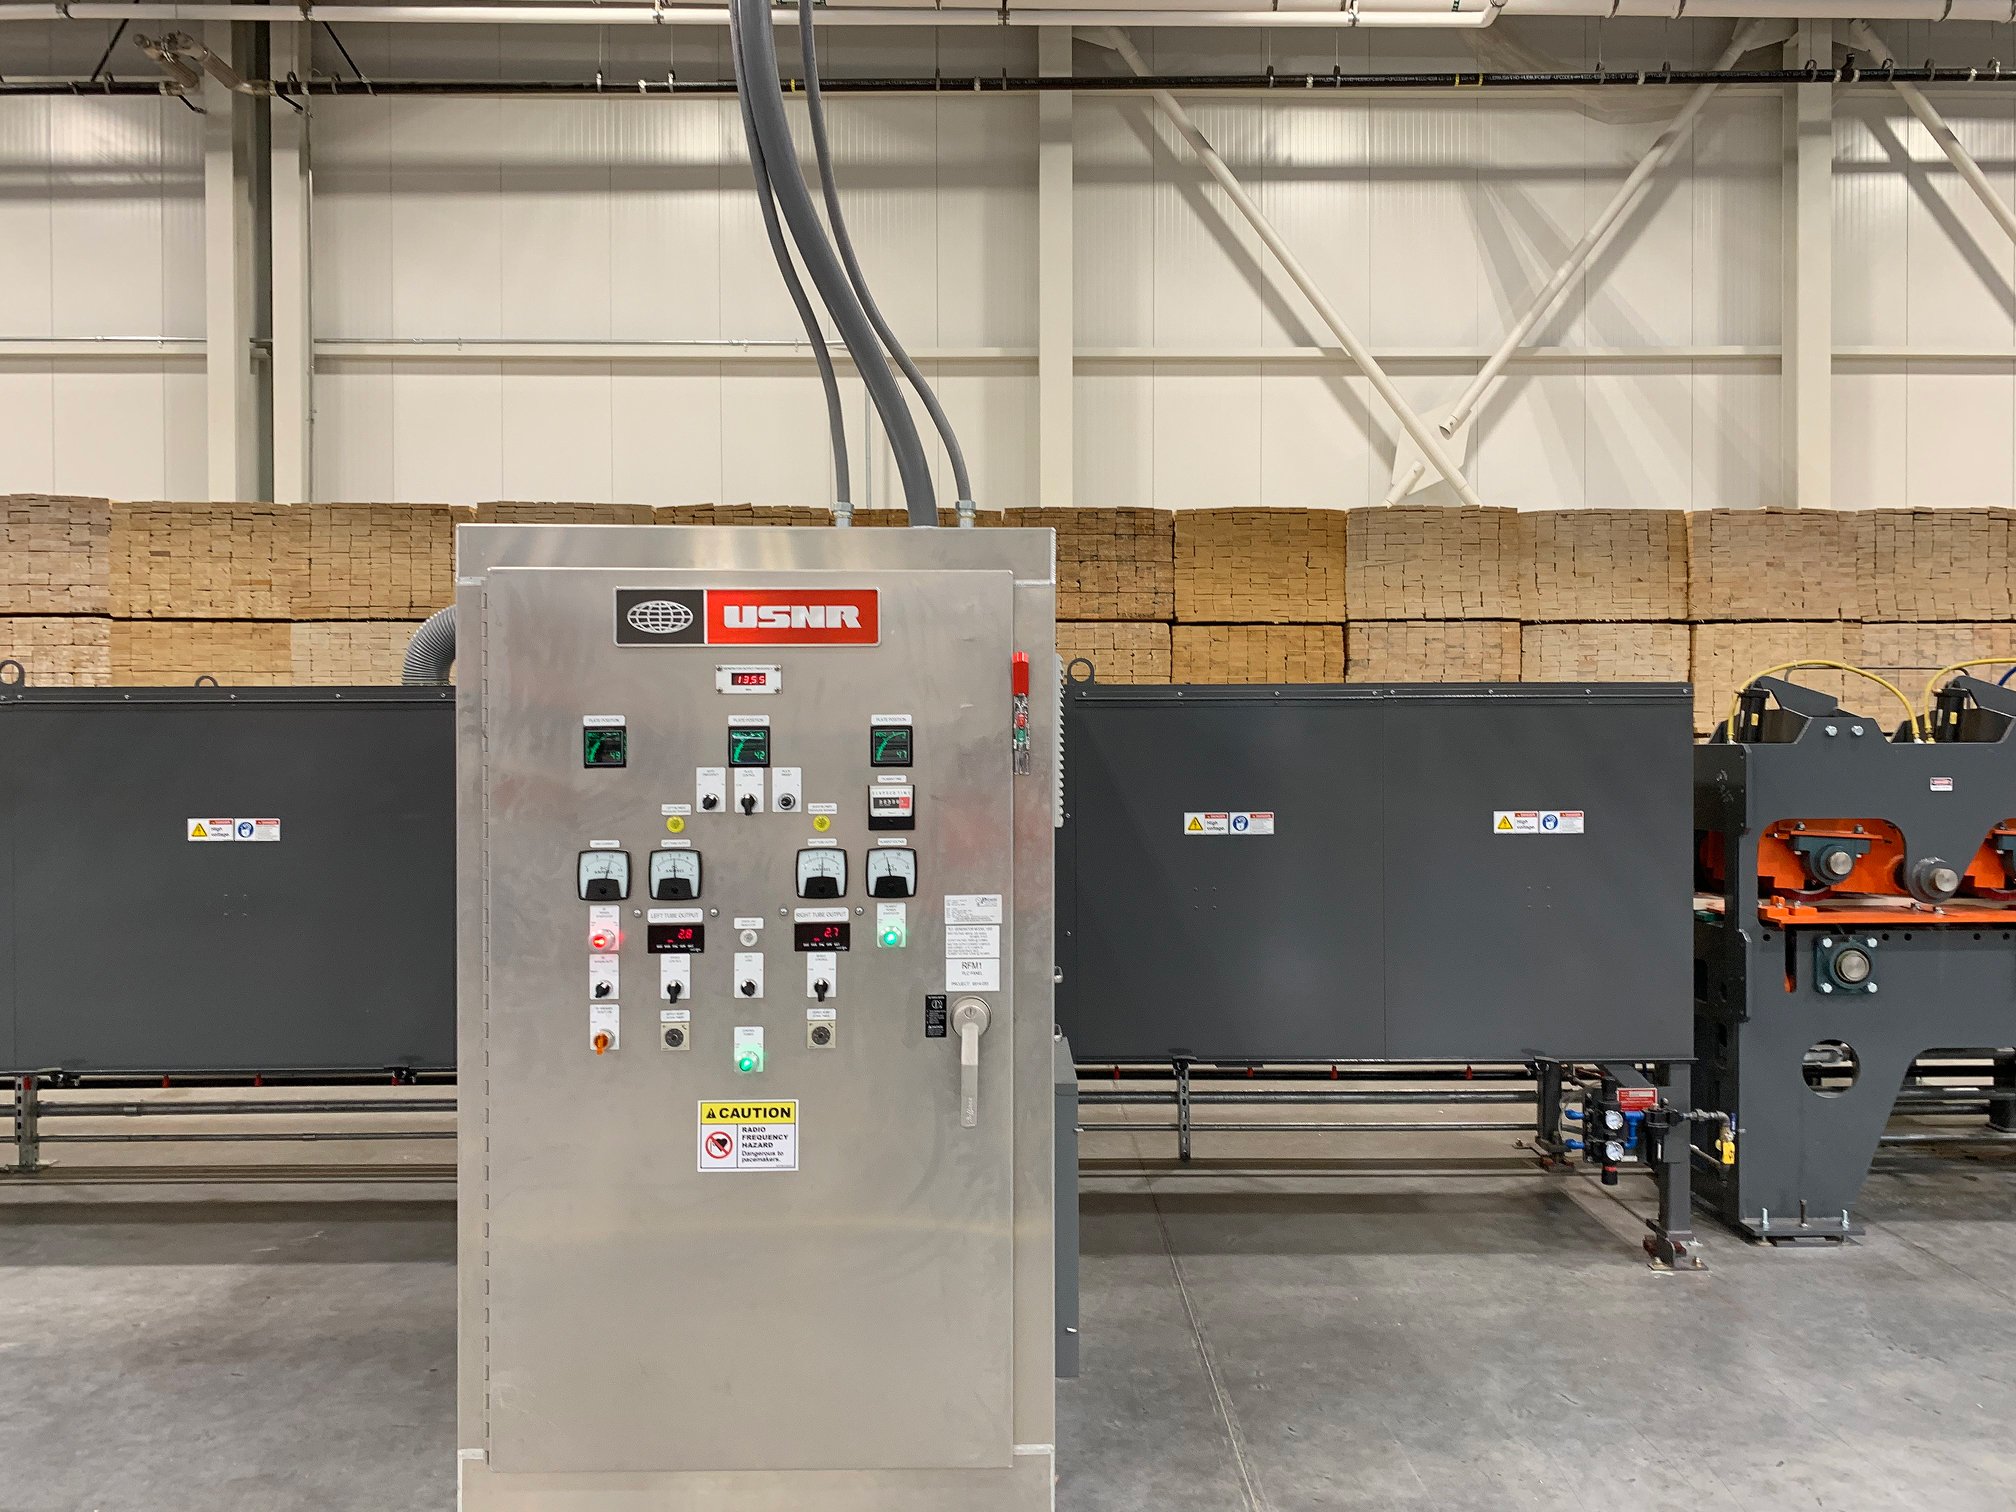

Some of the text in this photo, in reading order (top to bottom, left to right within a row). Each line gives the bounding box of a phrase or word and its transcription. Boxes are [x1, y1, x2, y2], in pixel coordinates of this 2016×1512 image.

[723, 605, 862, 629] USNR
[737, 675, 765, 685] 13.55
[719, 1107, 791, 1119] CAUTION
